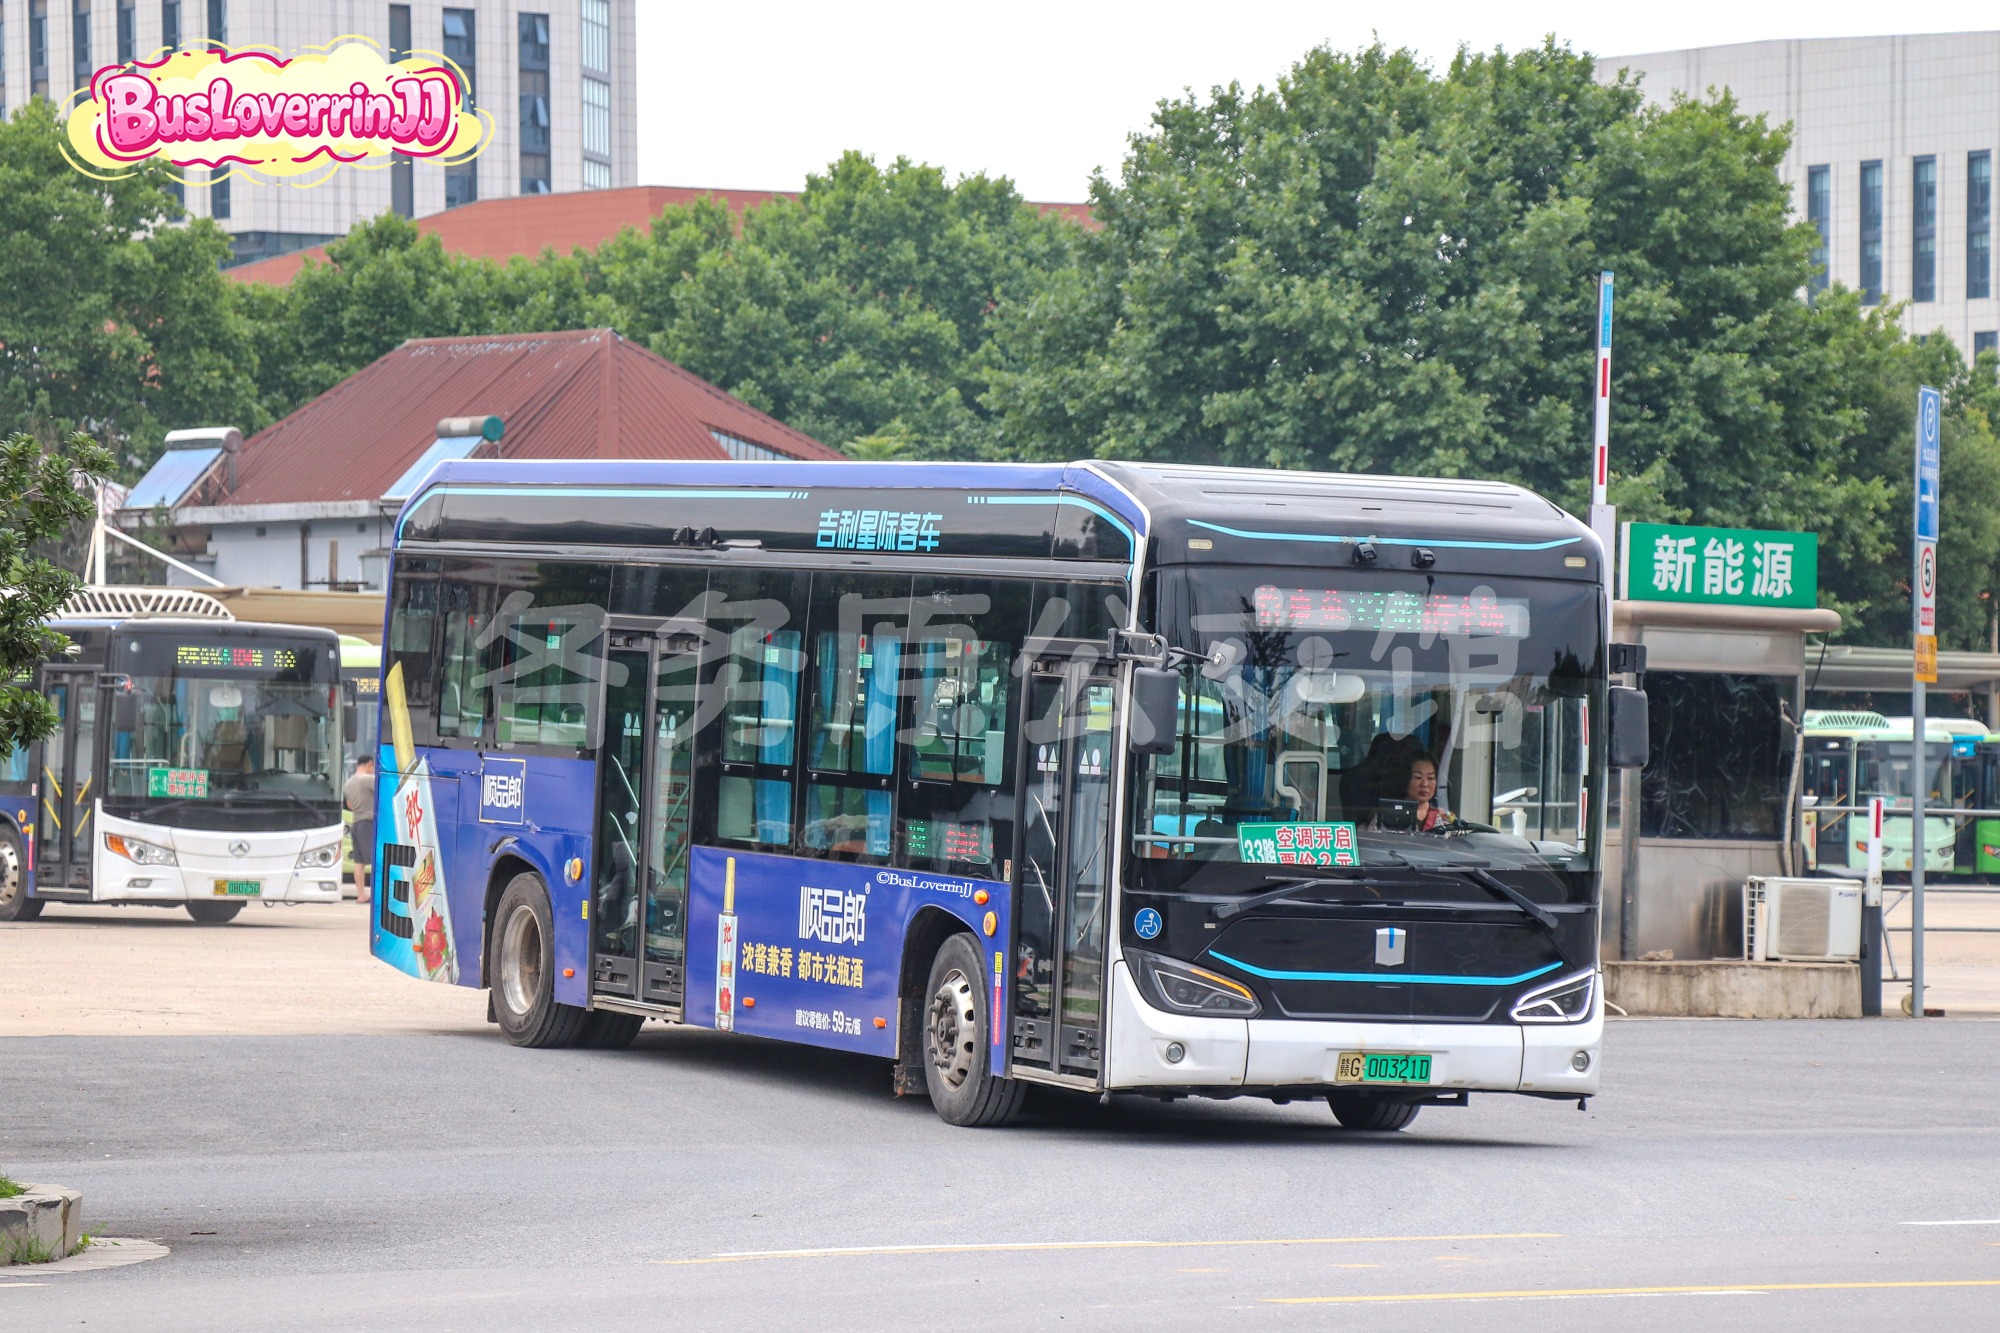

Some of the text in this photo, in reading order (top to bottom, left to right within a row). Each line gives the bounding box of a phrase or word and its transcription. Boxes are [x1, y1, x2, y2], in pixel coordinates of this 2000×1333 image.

[816, 509, 943, 552] 吉利星际客车
[1652, 534, 1794, 598] 新能源
[1925, 559, 1931, 587] 5
[483, 775, 521, 809] 顺品郎
[1276, 826, 1352, 849] 空调开启
[799, 886, 866, 946] 顺品郎
[742, 942, 864, 989] 浓酱兼香 都市光瓶酒
